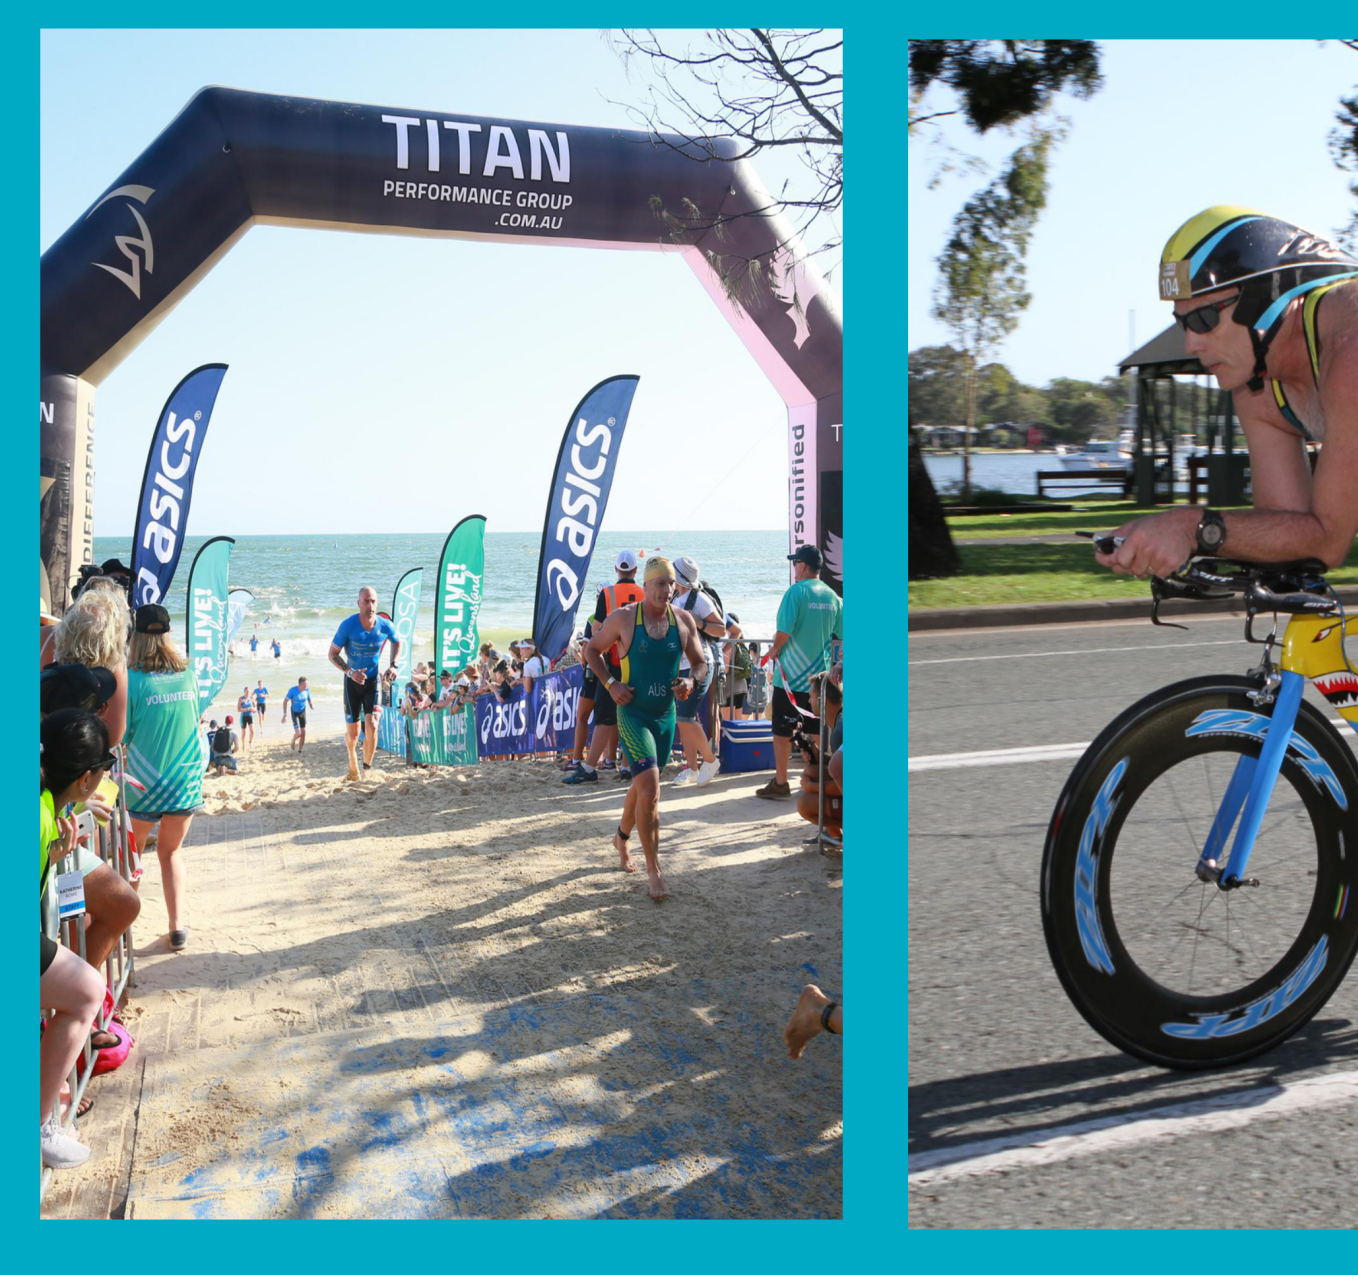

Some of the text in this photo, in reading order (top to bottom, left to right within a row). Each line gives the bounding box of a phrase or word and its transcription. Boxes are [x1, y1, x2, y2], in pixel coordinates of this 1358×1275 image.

[381, 115, 571, 183] TITAN
[383, 180, 573, 210] PERFORMANCE GROUP
[495, 212, 563, 230] .COM.AU
[1162, 277, 1180, 297] 104
[83, 401, 96, 563] DIFFERENCE
[791, 423, 806, 554] rsonified
[194, 588, 213, 651] LIVE!
[442, 563, 467, 668] IT'S LIVE!
[648, 685, 667, 697] AUS
